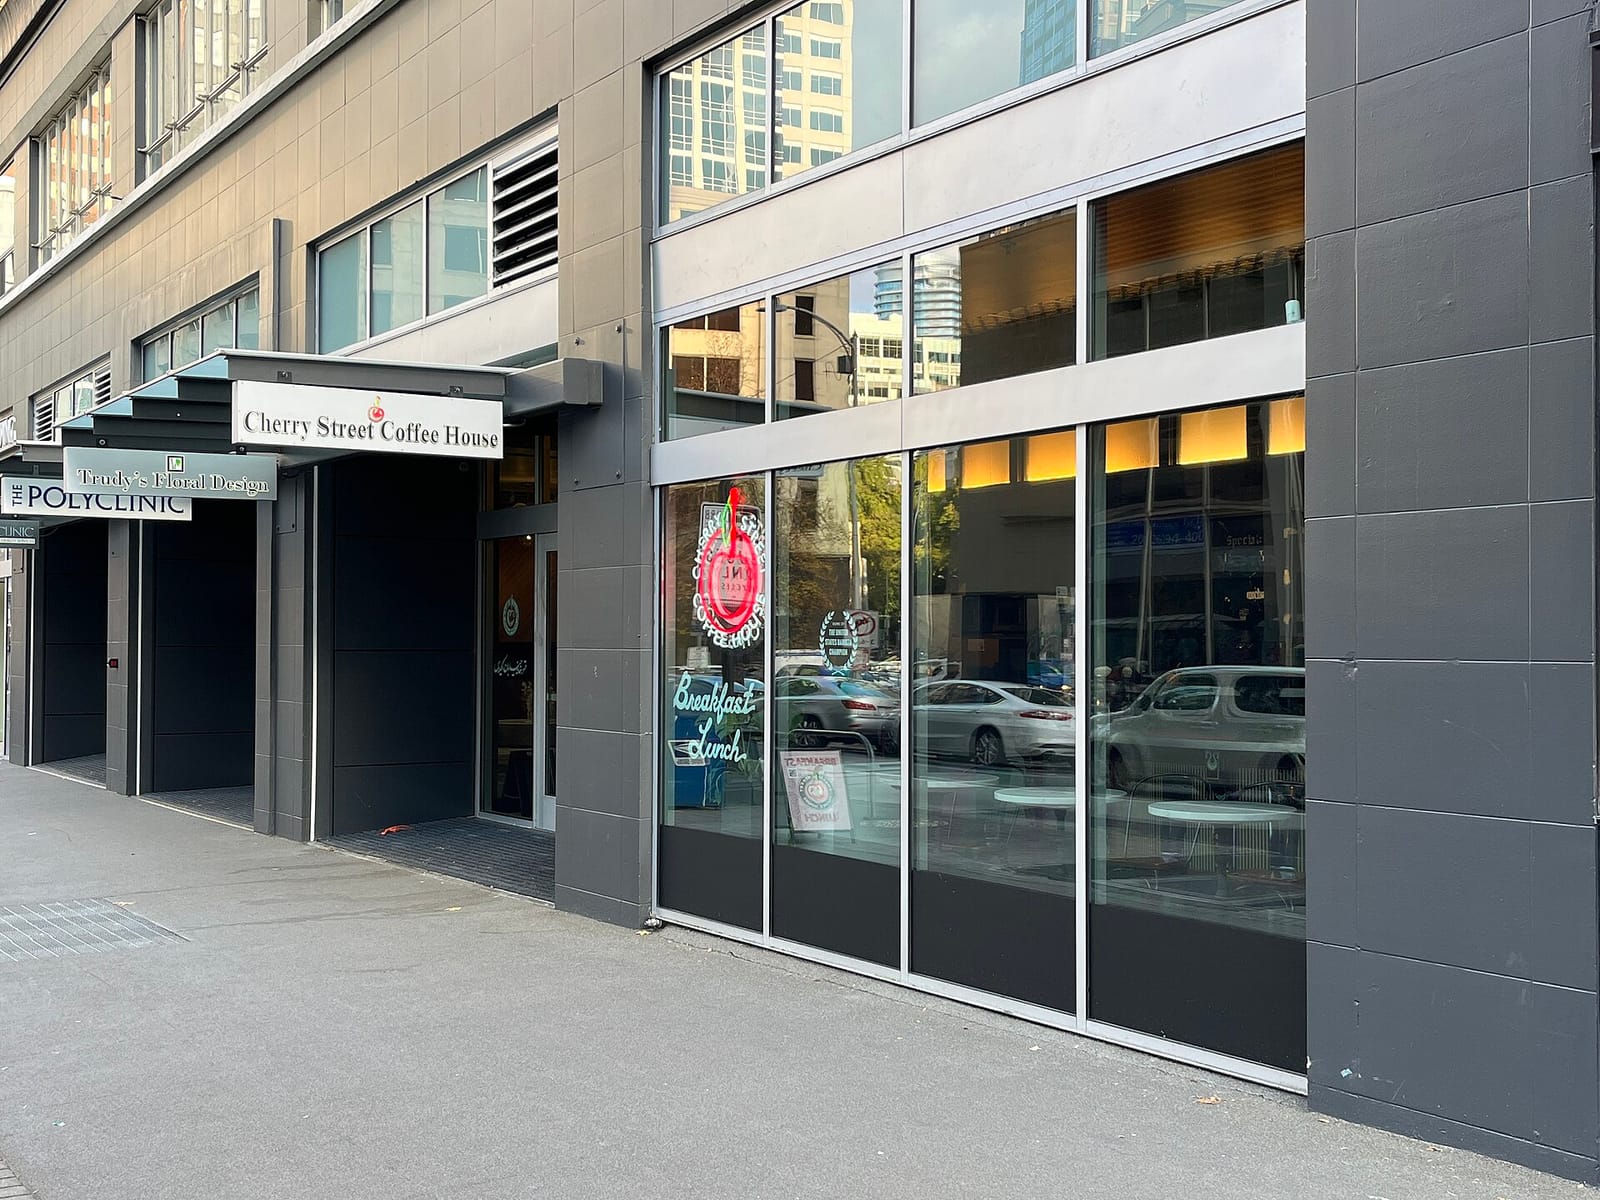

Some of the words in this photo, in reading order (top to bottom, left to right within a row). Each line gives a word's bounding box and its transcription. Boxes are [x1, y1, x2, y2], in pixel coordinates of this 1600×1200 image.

[243, 409, 312, 440] Cherry
[317, 416, 374, 440] Street
[381, 420, 439, 445] Coffee
[443, 425, 498, 448] House
[12, 484, 23, 507] THE
[28, 485, 184, 513] POLYCLINIC
[77, 469, 148, 492] Trudy's
[152, 472, 206, 490] Floral
[210, 474, 269, 496] Design
[673, 671, 756, 725] Breakfast
[688, 718, 747, 763] Lunch
